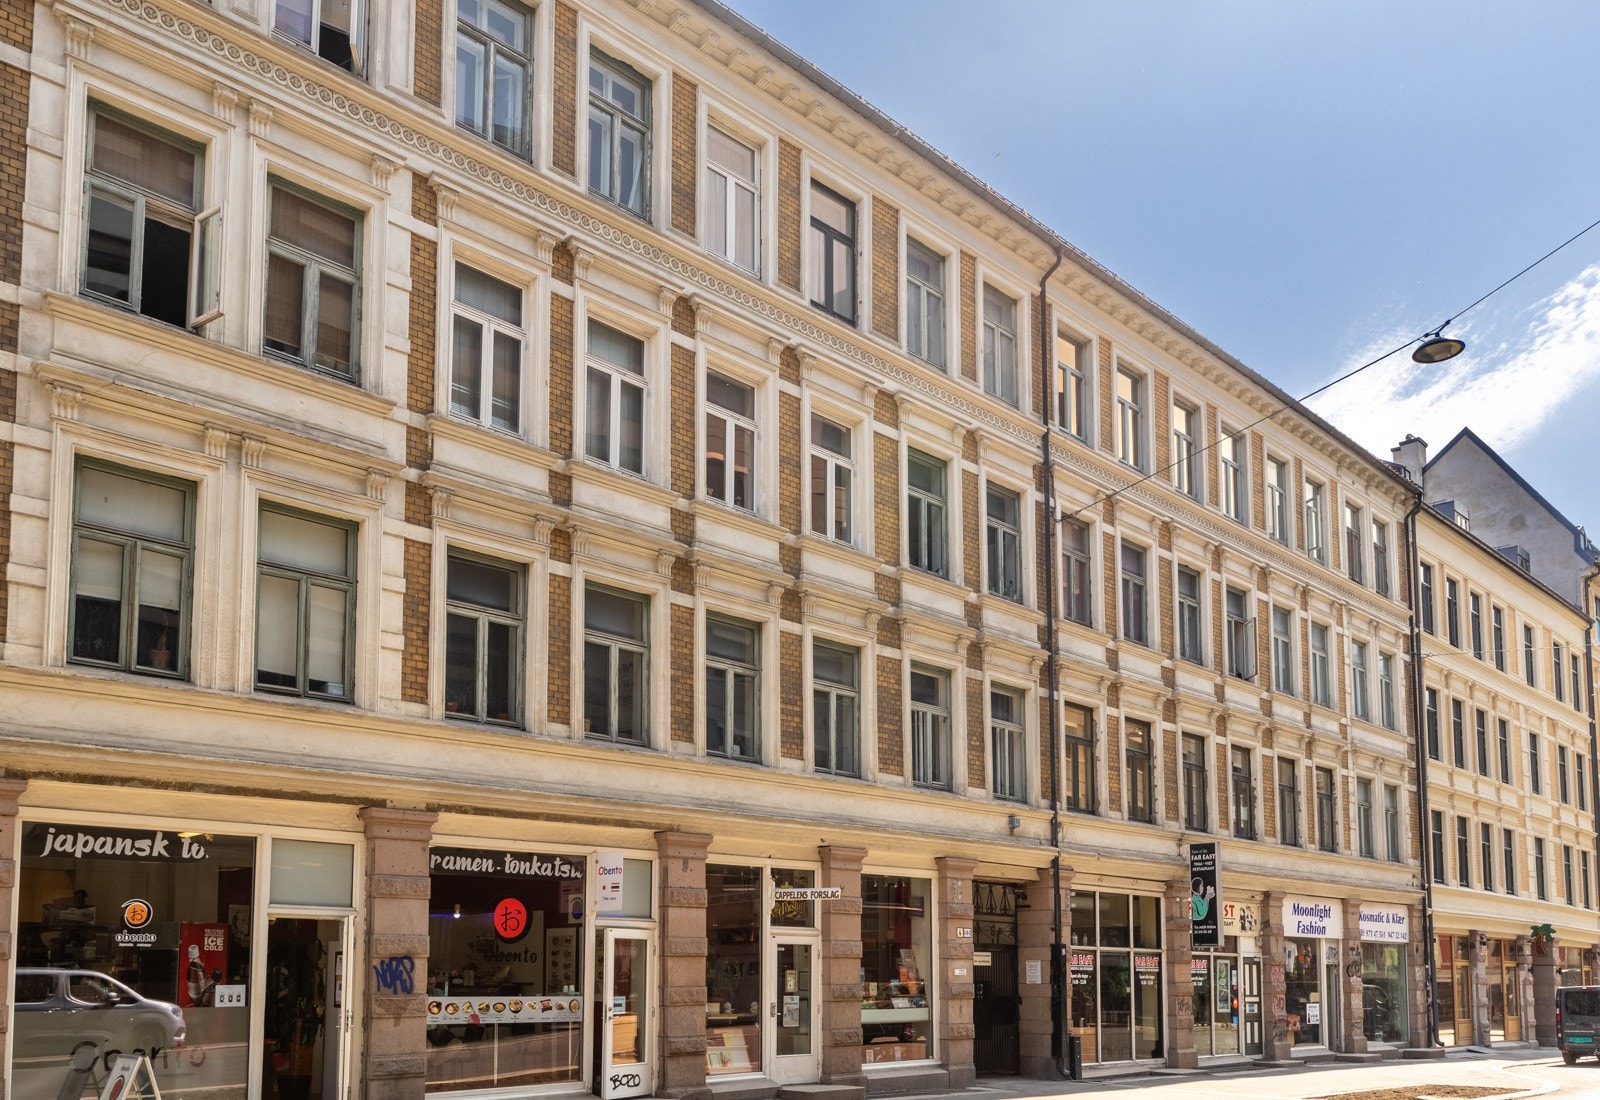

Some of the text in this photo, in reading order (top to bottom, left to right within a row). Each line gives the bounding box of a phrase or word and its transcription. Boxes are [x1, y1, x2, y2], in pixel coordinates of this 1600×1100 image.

[39, 827, 171, 859] japansk
[430, 853, 495, 873] ramen
[598, 866, 622, 876] Obento
[775, 890, 840, 900] CAPPELENS FORSLAG
[1292, 902, 1331, 922] Moonlight
[1386, 912, 1390, 924] &
[500, 906, 522, 932] お
[1297, 920, 1326, 935] Fashion
[115, 930, 157, 942] obento
[204, 937, 224, 946] ICE
